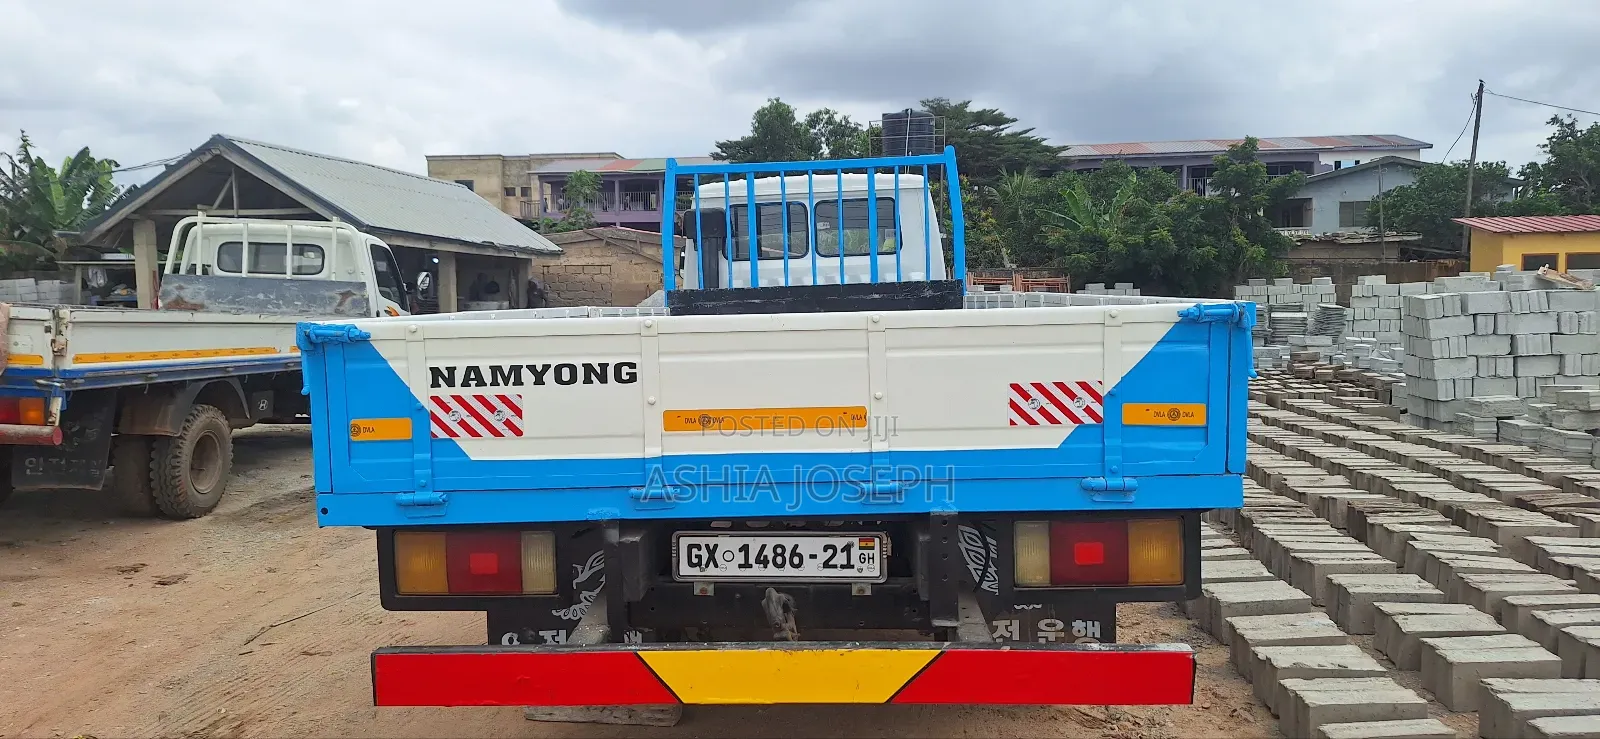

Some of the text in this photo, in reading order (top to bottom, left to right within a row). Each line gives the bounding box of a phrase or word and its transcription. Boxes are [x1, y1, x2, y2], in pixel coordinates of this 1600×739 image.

[429, 362, 638, 388] NAMYONG
[1153, 410, 1166, 418] DVLA
[687, 543, 719, 569] GX
[858, 552, 875, 565] GH
